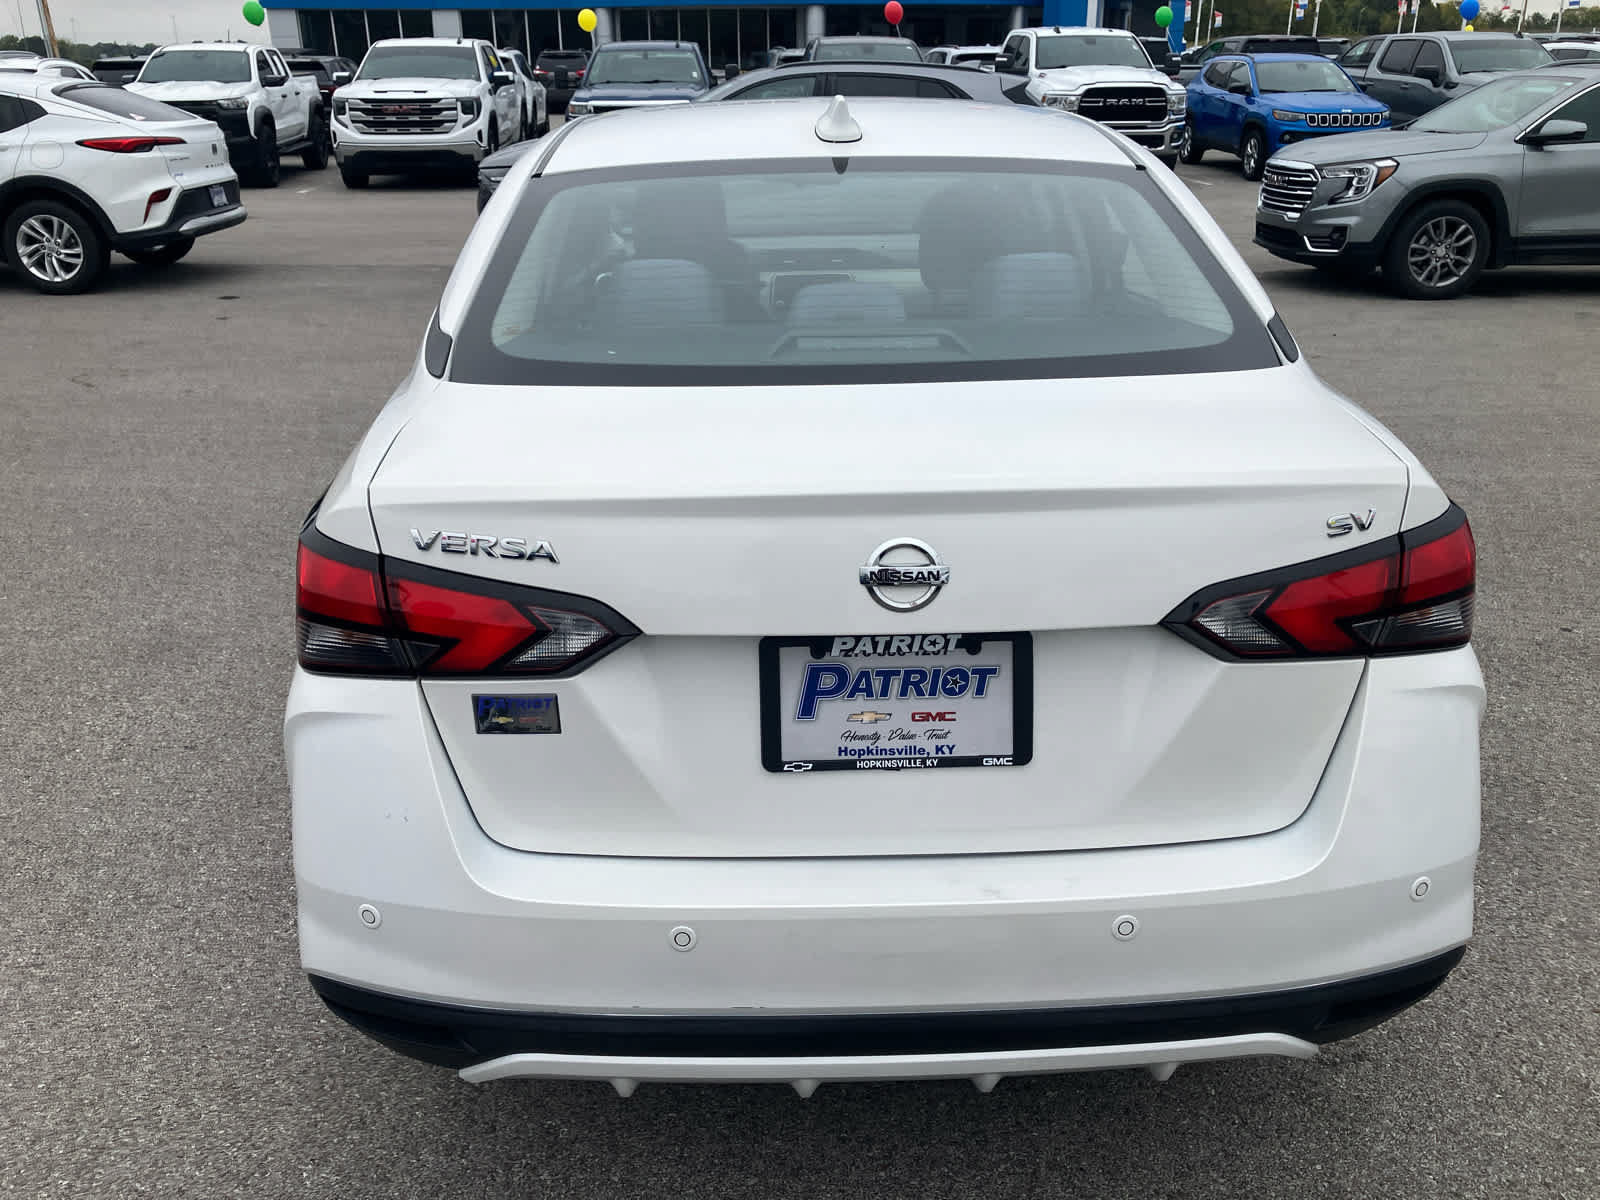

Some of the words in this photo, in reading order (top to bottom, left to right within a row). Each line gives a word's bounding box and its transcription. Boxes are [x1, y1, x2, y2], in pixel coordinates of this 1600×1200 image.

[1326, 508, 1377, 538] SV
[409, 527, 561, 564] VERSA
[869, 570, 941, 583] NISSAN
[830, 634, 962, 657] PATRIOT
[911, 711, 957, 722] GMC
[840, 729, 881, 746] Honesty
[887, 728, 917, 742] Value
[923, 729, 952, 742] Trust
[838, 746, 930, 758] Hopkinsville,
[935, 744, 956, 756] KY
[856, 759, 924, 769] HOPKINSVILLE,
[926, 758, 938, 768] KY
[982, 757, 1013, 766] GMC
